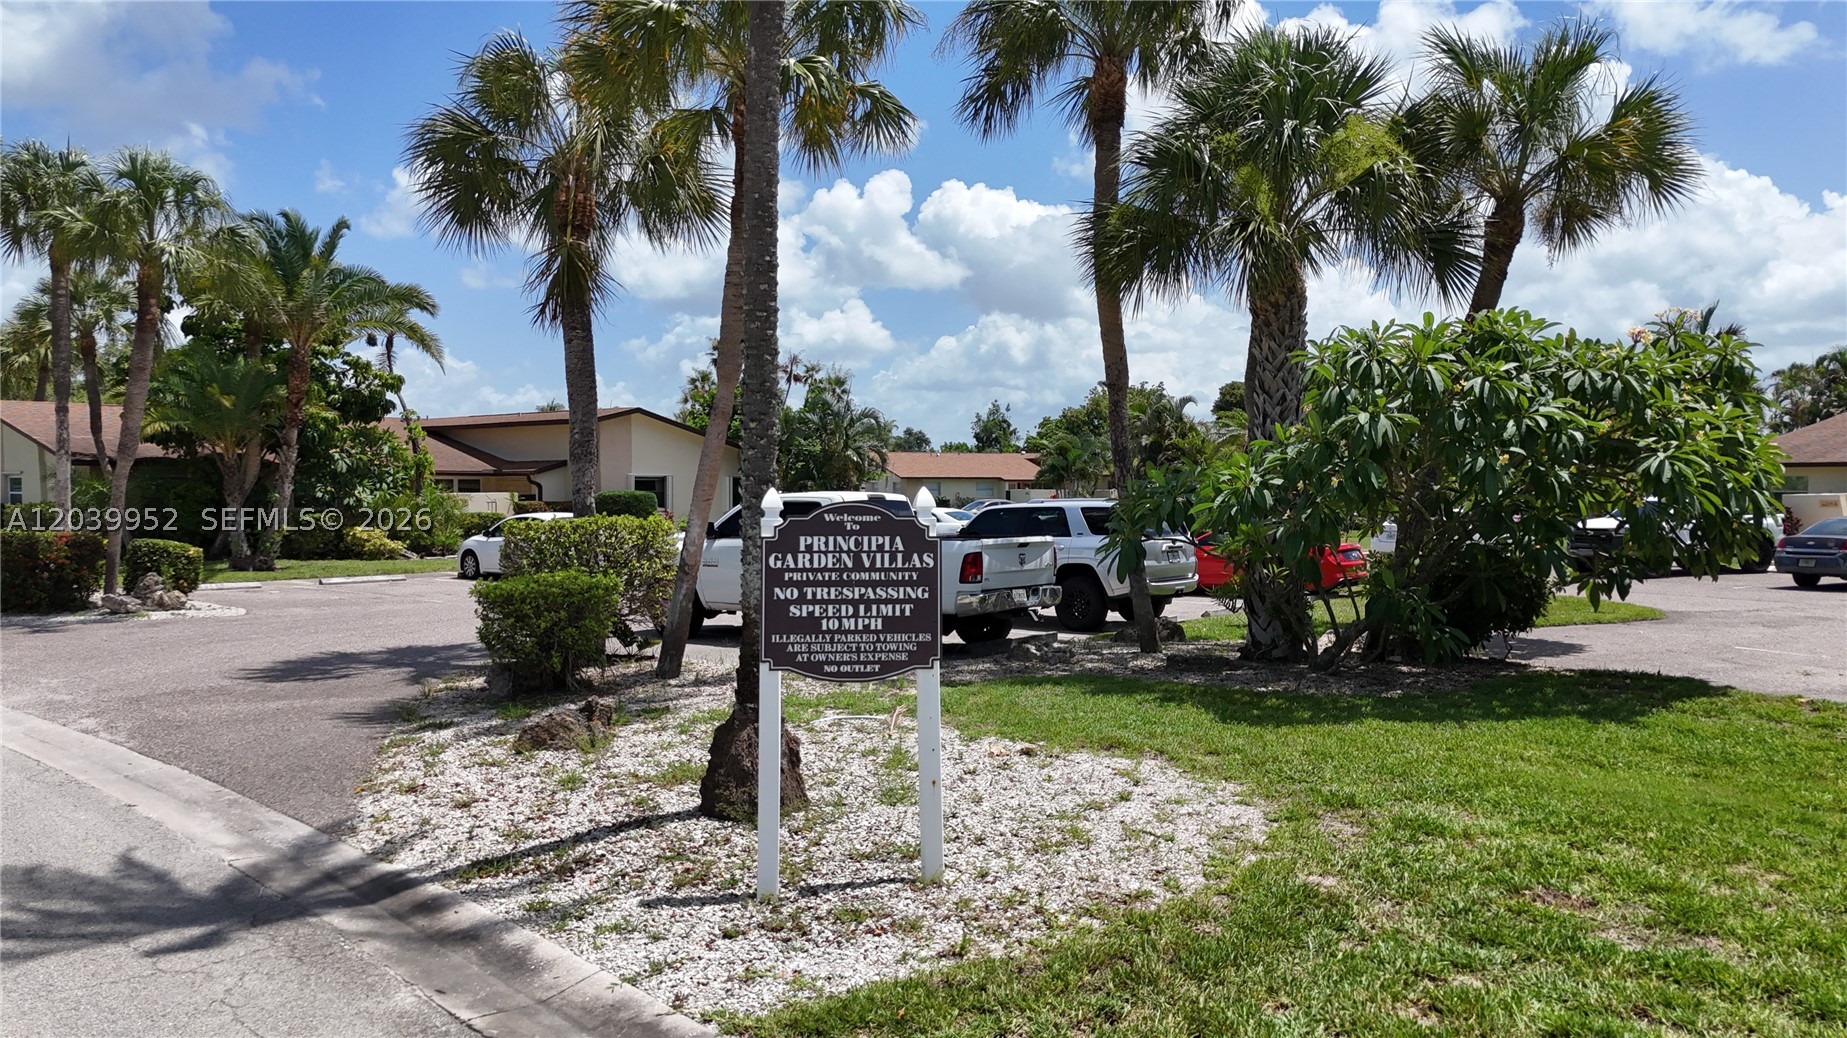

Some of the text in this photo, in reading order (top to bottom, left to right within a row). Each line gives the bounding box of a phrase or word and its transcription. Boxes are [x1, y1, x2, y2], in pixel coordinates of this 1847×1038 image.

[845, 522, 860, 531] To
[800, 536, 904, 551] PRINCIPIA
[769, 553, 934, 568] GARDEN VILLAS
[785, 572, 918, 580] PRIVATE COMMUNITY
[774, 587, 928, 599] NO TRESPASSING
[790, 604, 913, 617] SPEED LIMIT
[821, 618, 882, 630] 10 MPH
[772, 634, 831, 642] ILLEGALLY
[835, 634, 877, 642] PARKED
[787, 644, 808, 652] ARE
[859, 643, 873, 651] TO
[875, 643, 916, 651] TOWING
[811, 653, 857, 661] OWNER'S
